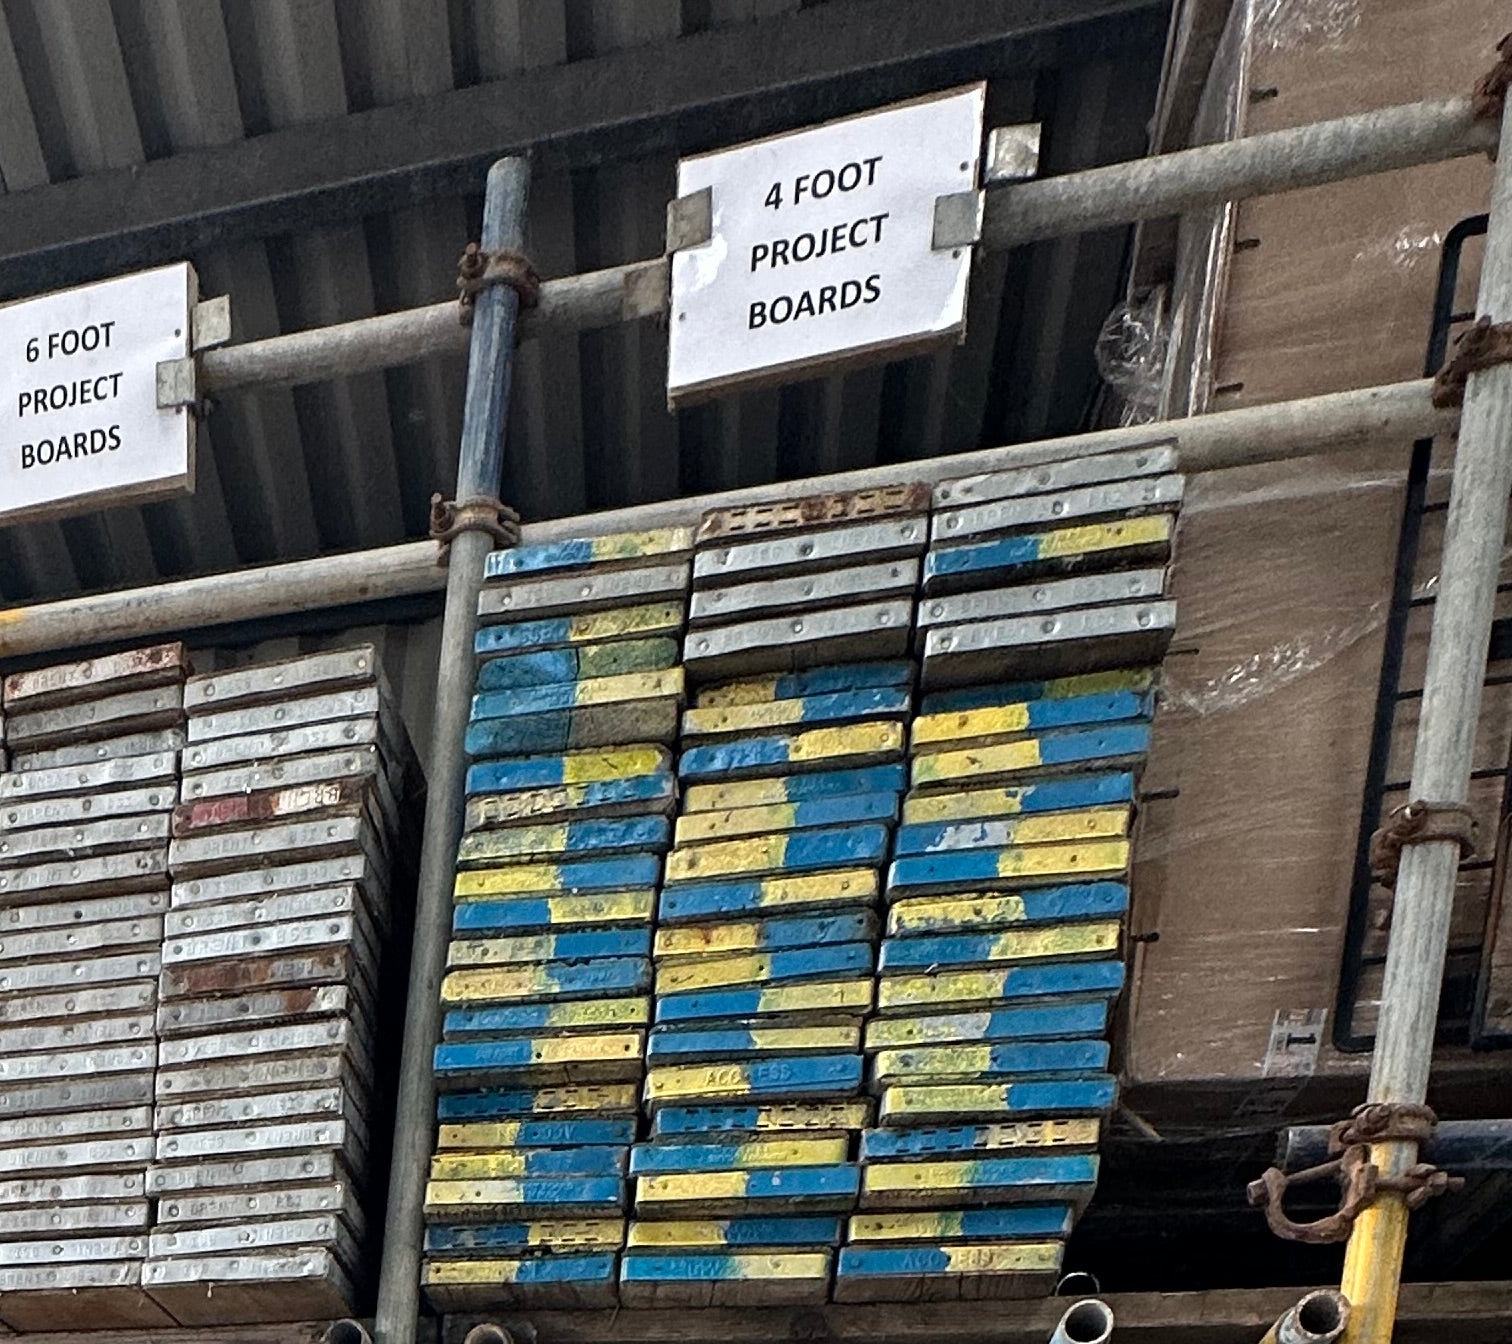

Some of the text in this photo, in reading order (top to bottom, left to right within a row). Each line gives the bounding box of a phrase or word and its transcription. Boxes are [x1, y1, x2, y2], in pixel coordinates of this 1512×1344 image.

[764, 155, 884, 211] 4 FOOT
[750, 211, 890, 272] PROJECT
[748, 274, 881, 330] BOARDS
[26, 320, 116, 363] 6 FOOT
[18, 371, 124, 418] PROJECT
[21, 424, 122, 470] BOARDS
